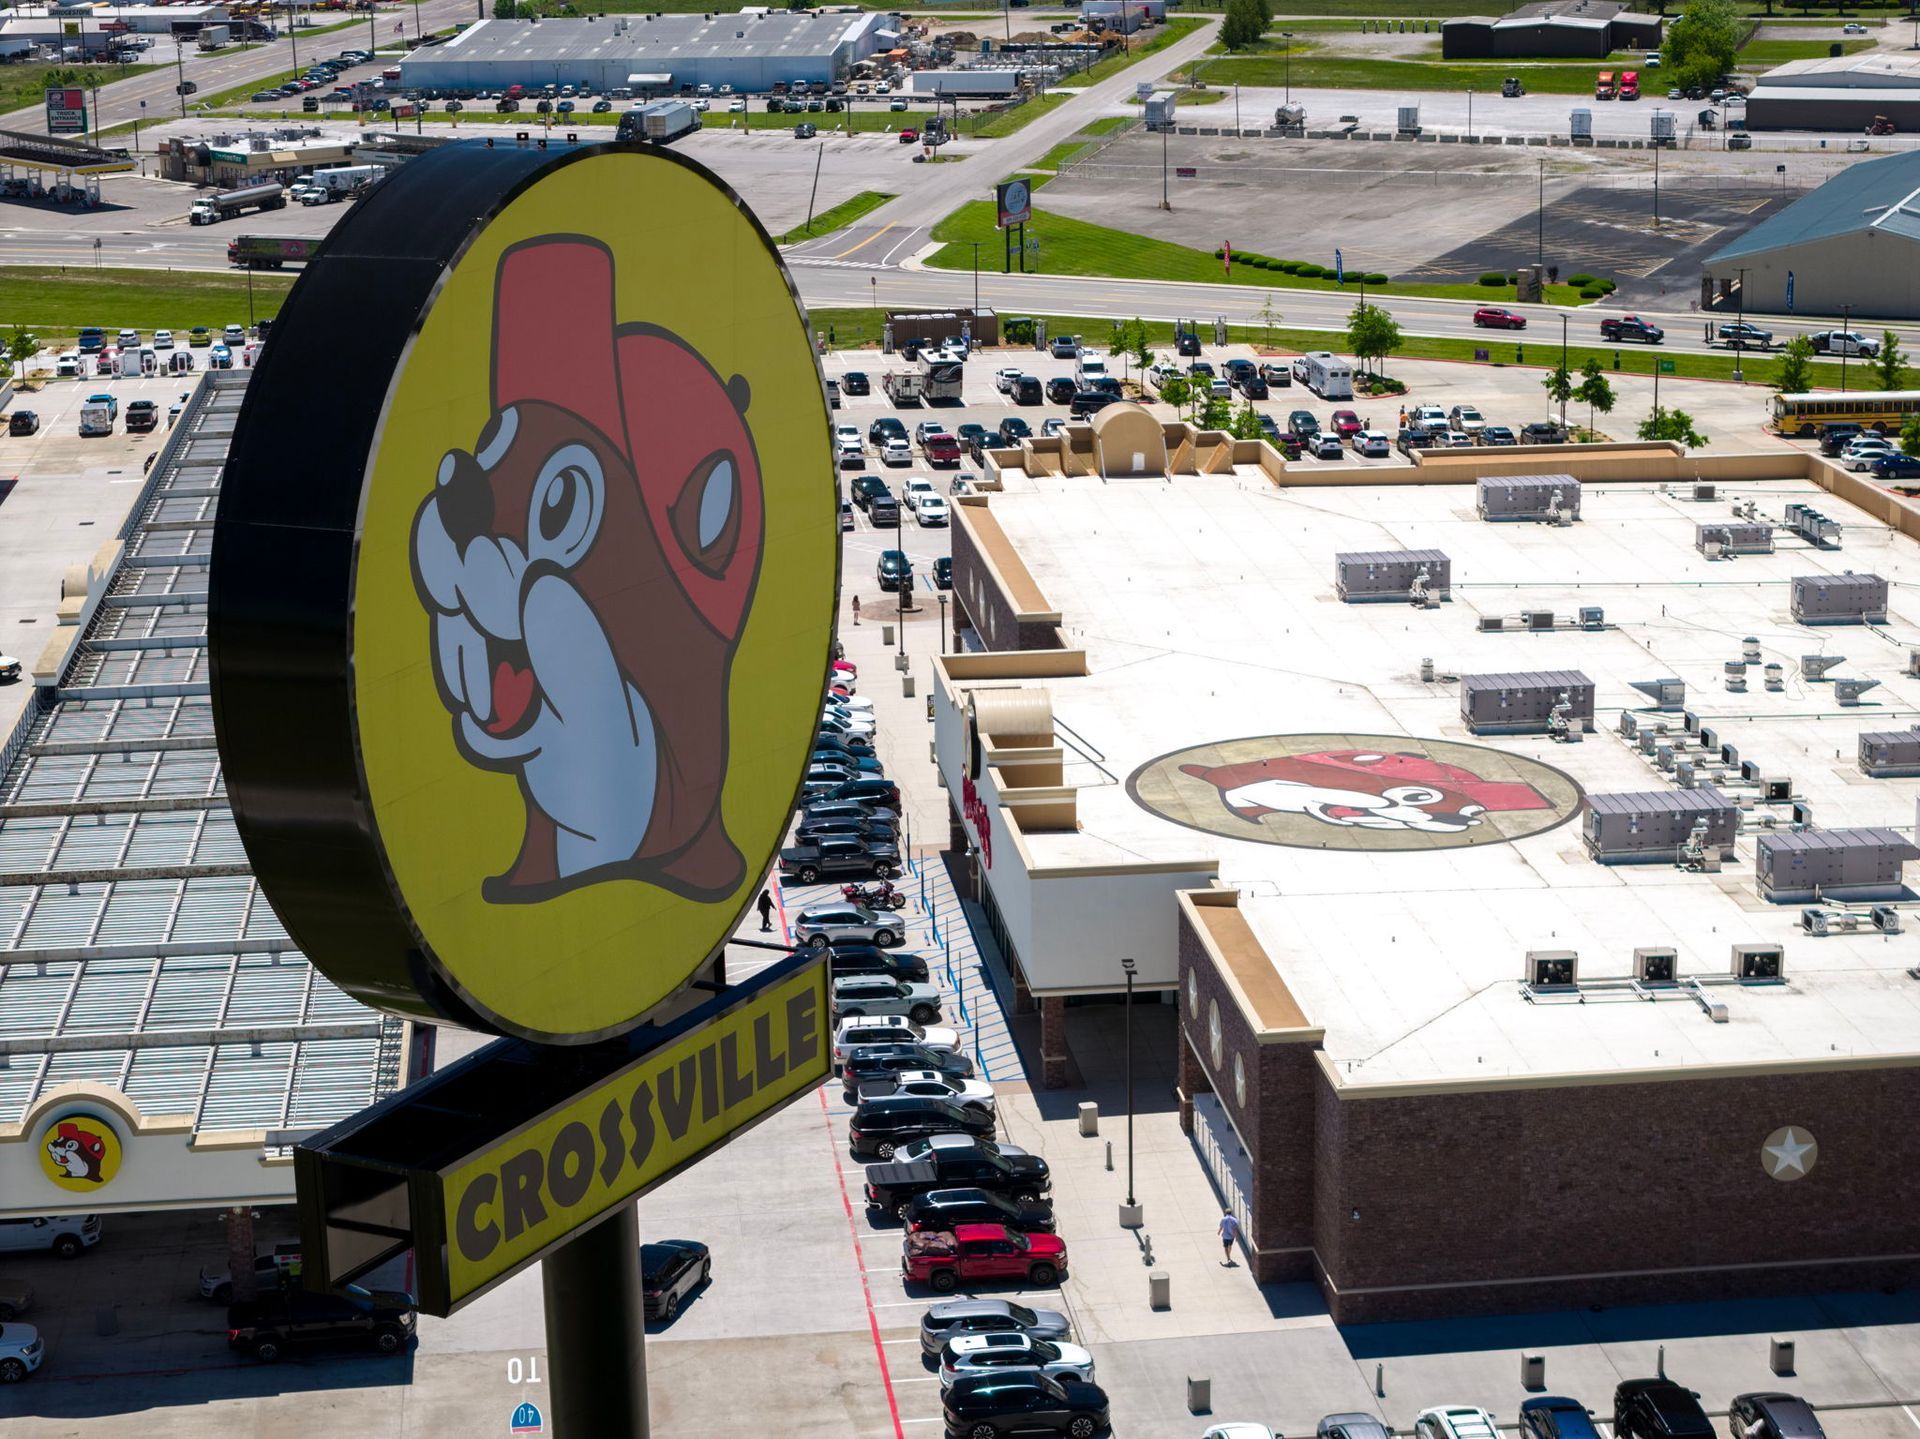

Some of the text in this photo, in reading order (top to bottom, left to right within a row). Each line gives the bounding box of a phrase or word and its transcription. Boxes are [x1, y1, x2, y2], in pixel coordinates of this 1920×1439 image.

[456, 987, 818, 1262] CROSSVILLE
[508, 1357, 541, 1384] TO
[519, 1408, 534, 1424] 40
